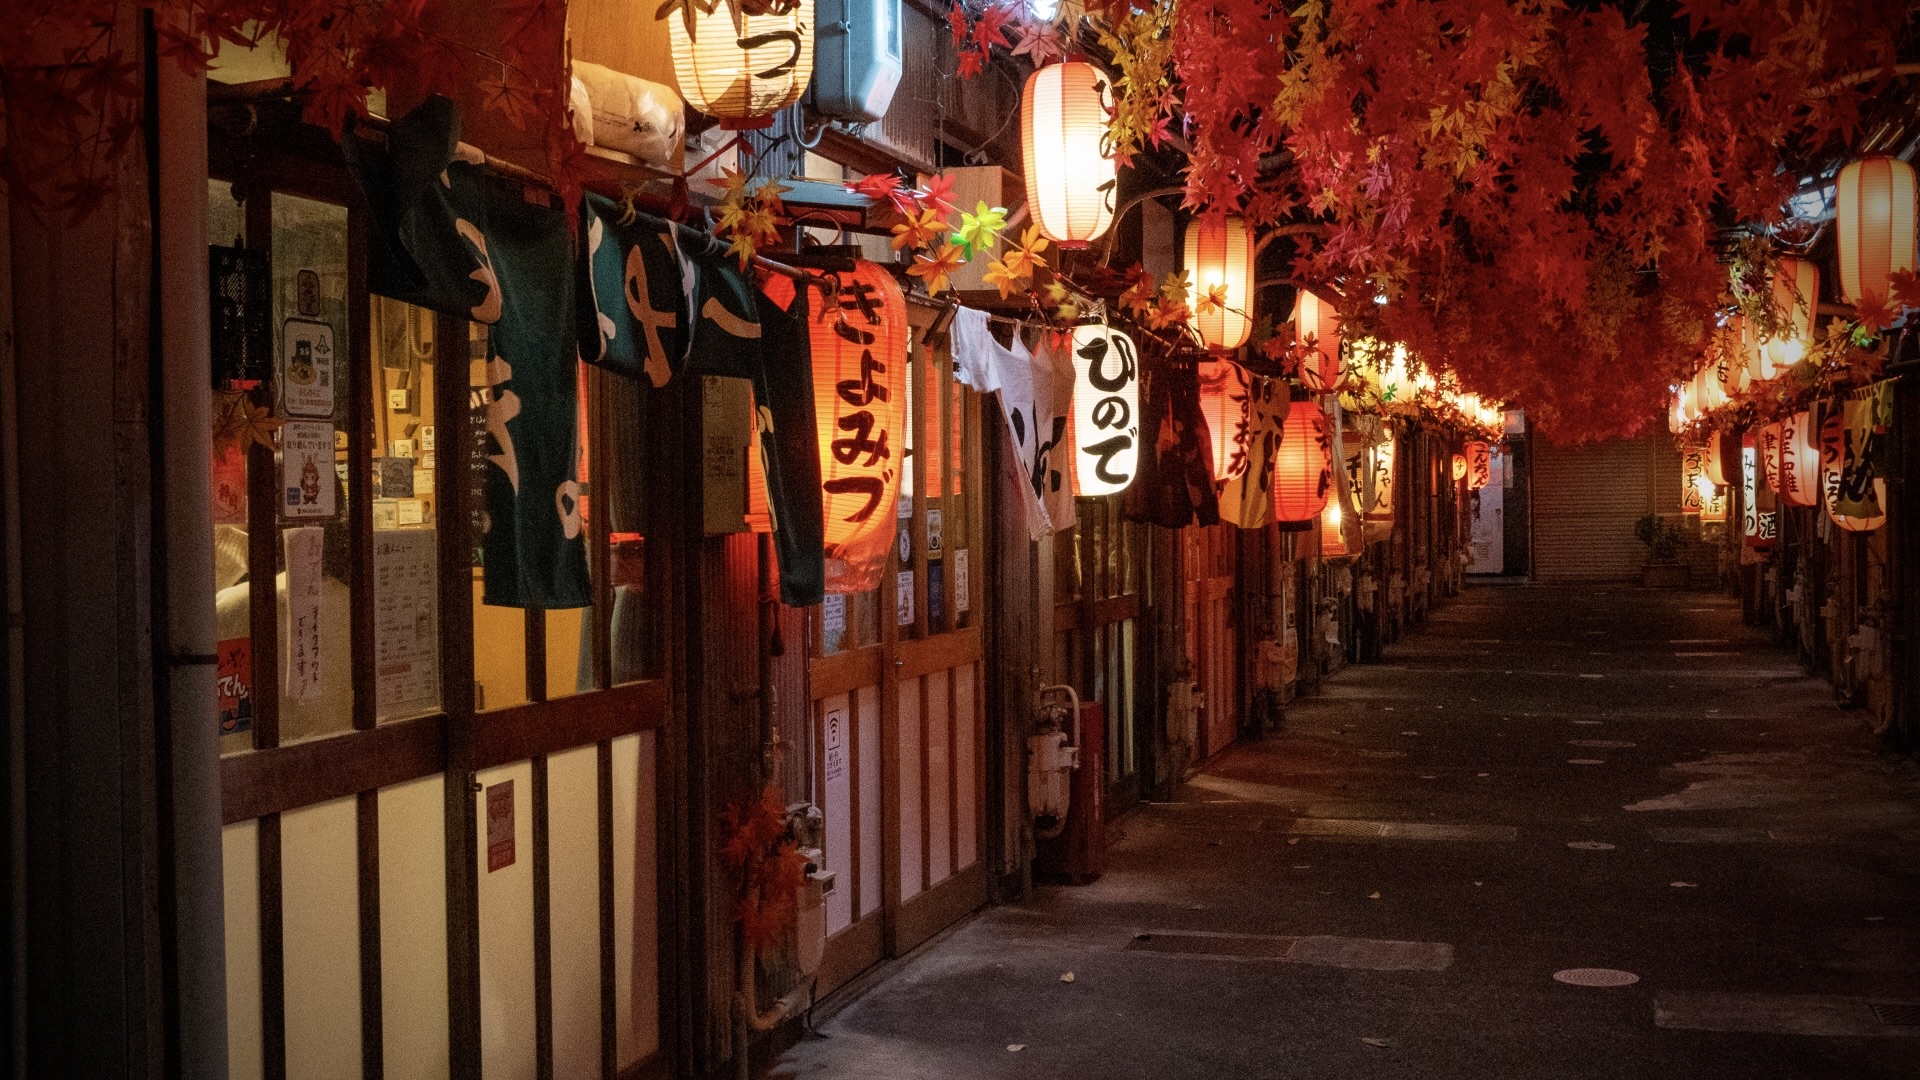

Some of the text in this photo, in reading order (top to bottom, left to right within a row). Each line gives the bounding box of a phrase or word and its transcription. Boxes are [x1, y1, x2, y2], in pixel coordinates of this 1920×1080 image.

[823, 278, 894, 524] きよみづ
[1077, 337, 1137, 485] ひので
